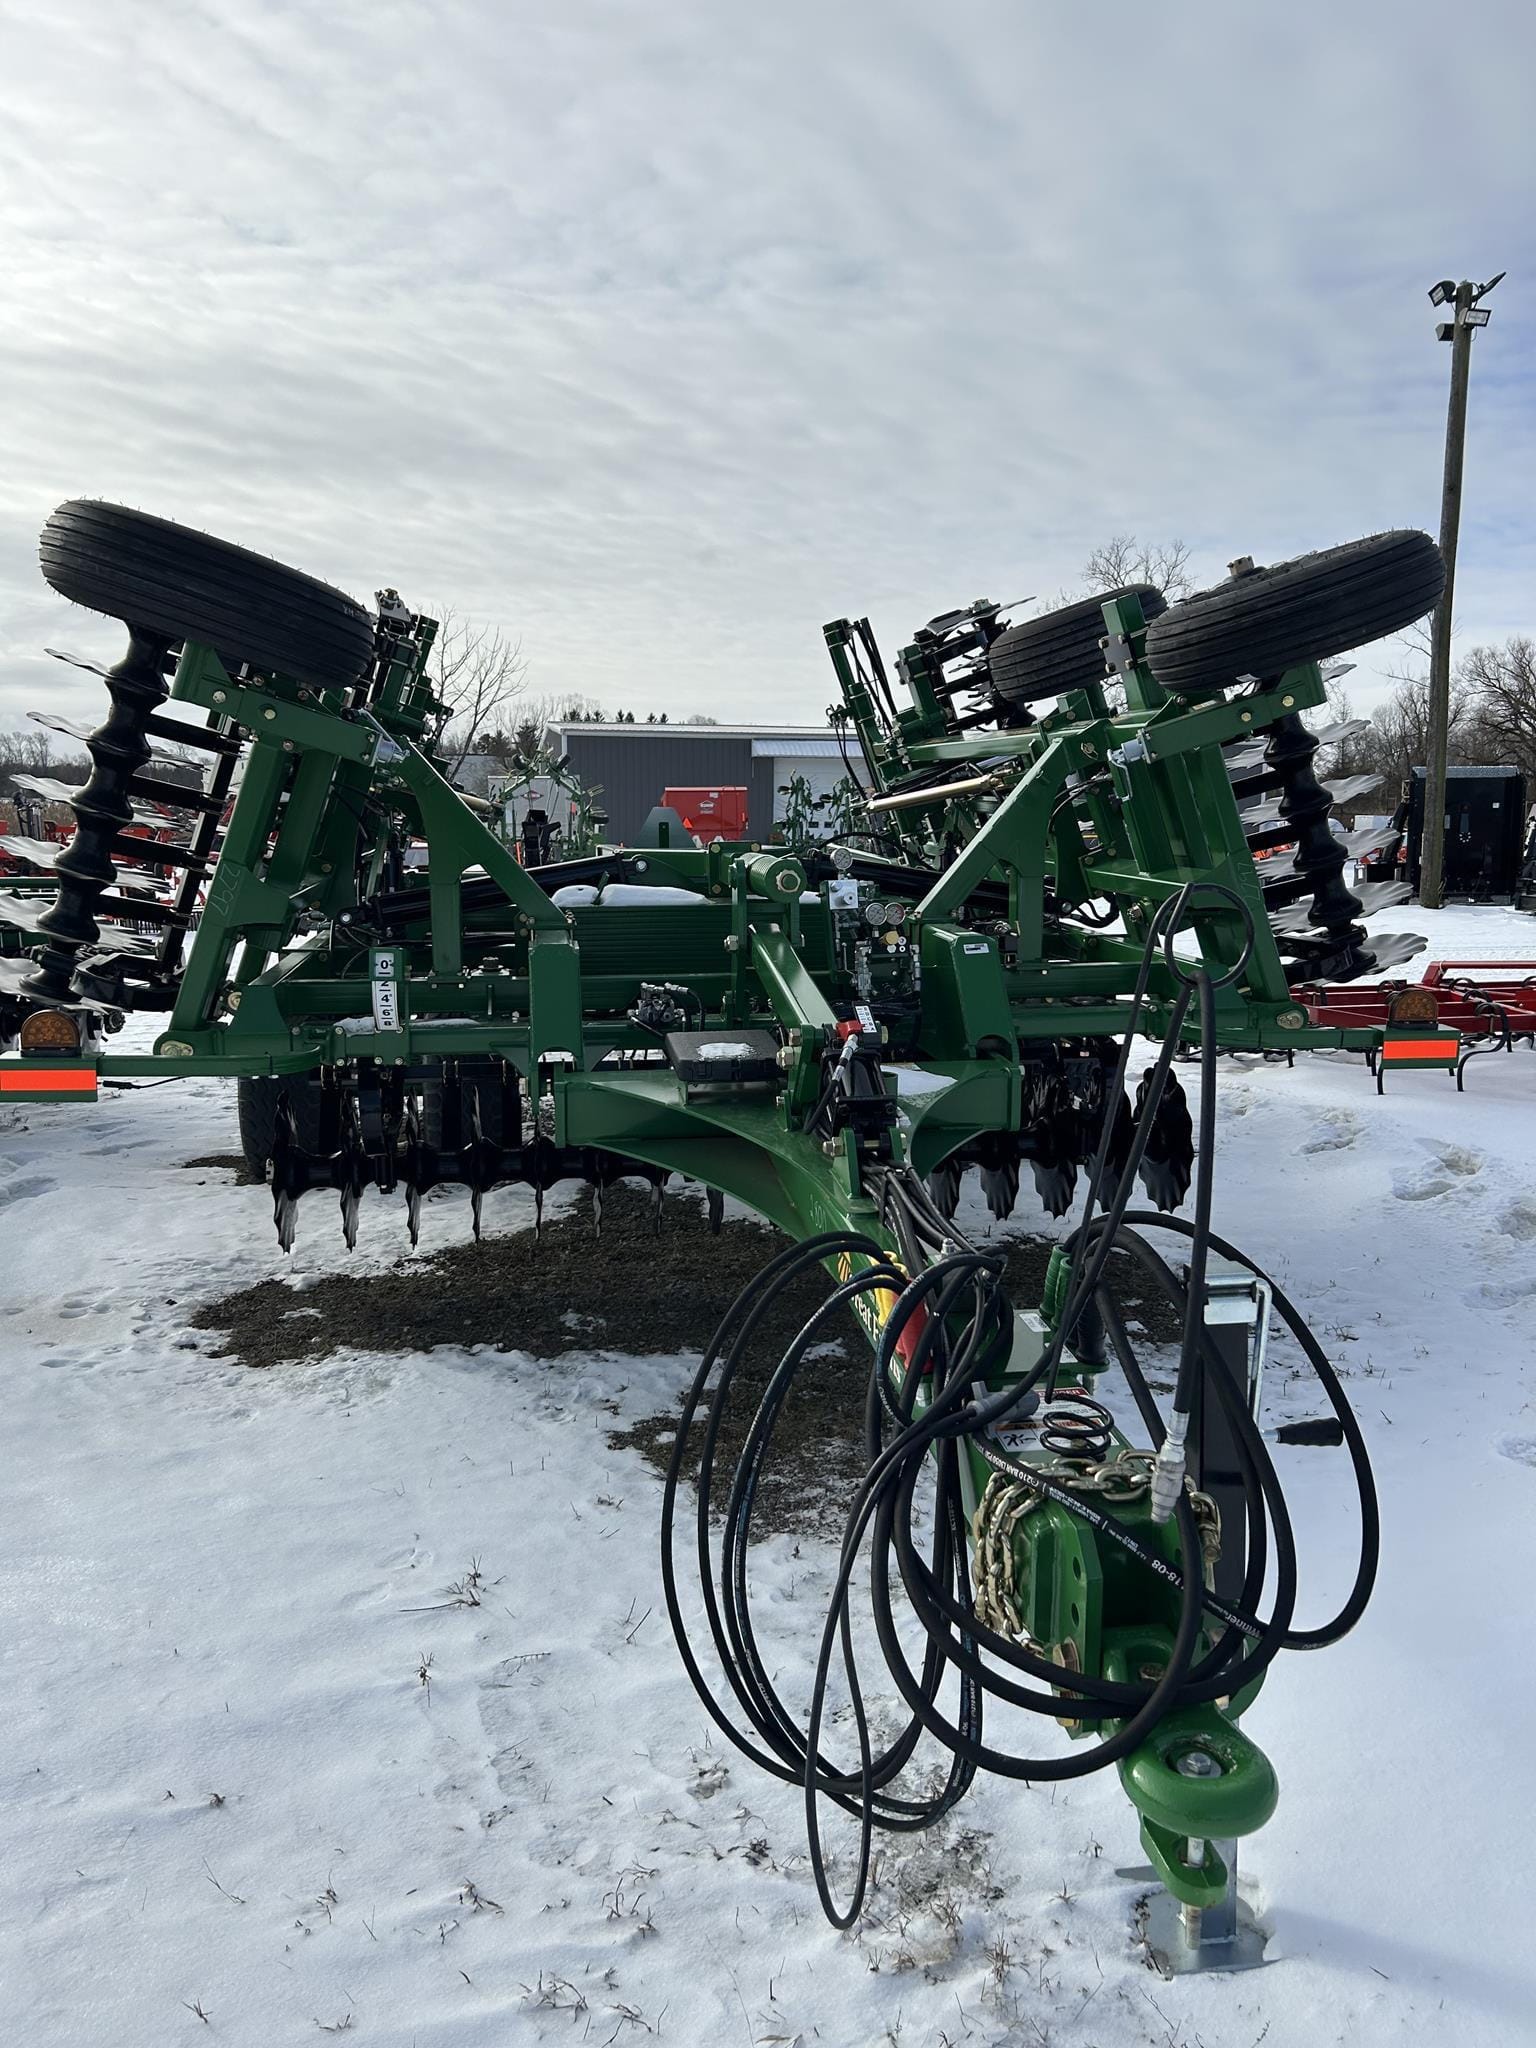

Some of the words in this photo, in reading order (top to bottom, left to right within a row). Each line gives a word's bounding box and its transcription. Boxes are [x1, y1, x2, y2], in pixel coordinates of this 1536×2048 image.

[851, 1294, 872, 1332] reat
[1003, 1462, 1020, 1478] BAR
[1016, 1469, 1033, 1485] 210
[1151, 1559, 1185, 1590] 18-08
[1224, 1612, 1261, 1638] Winner
